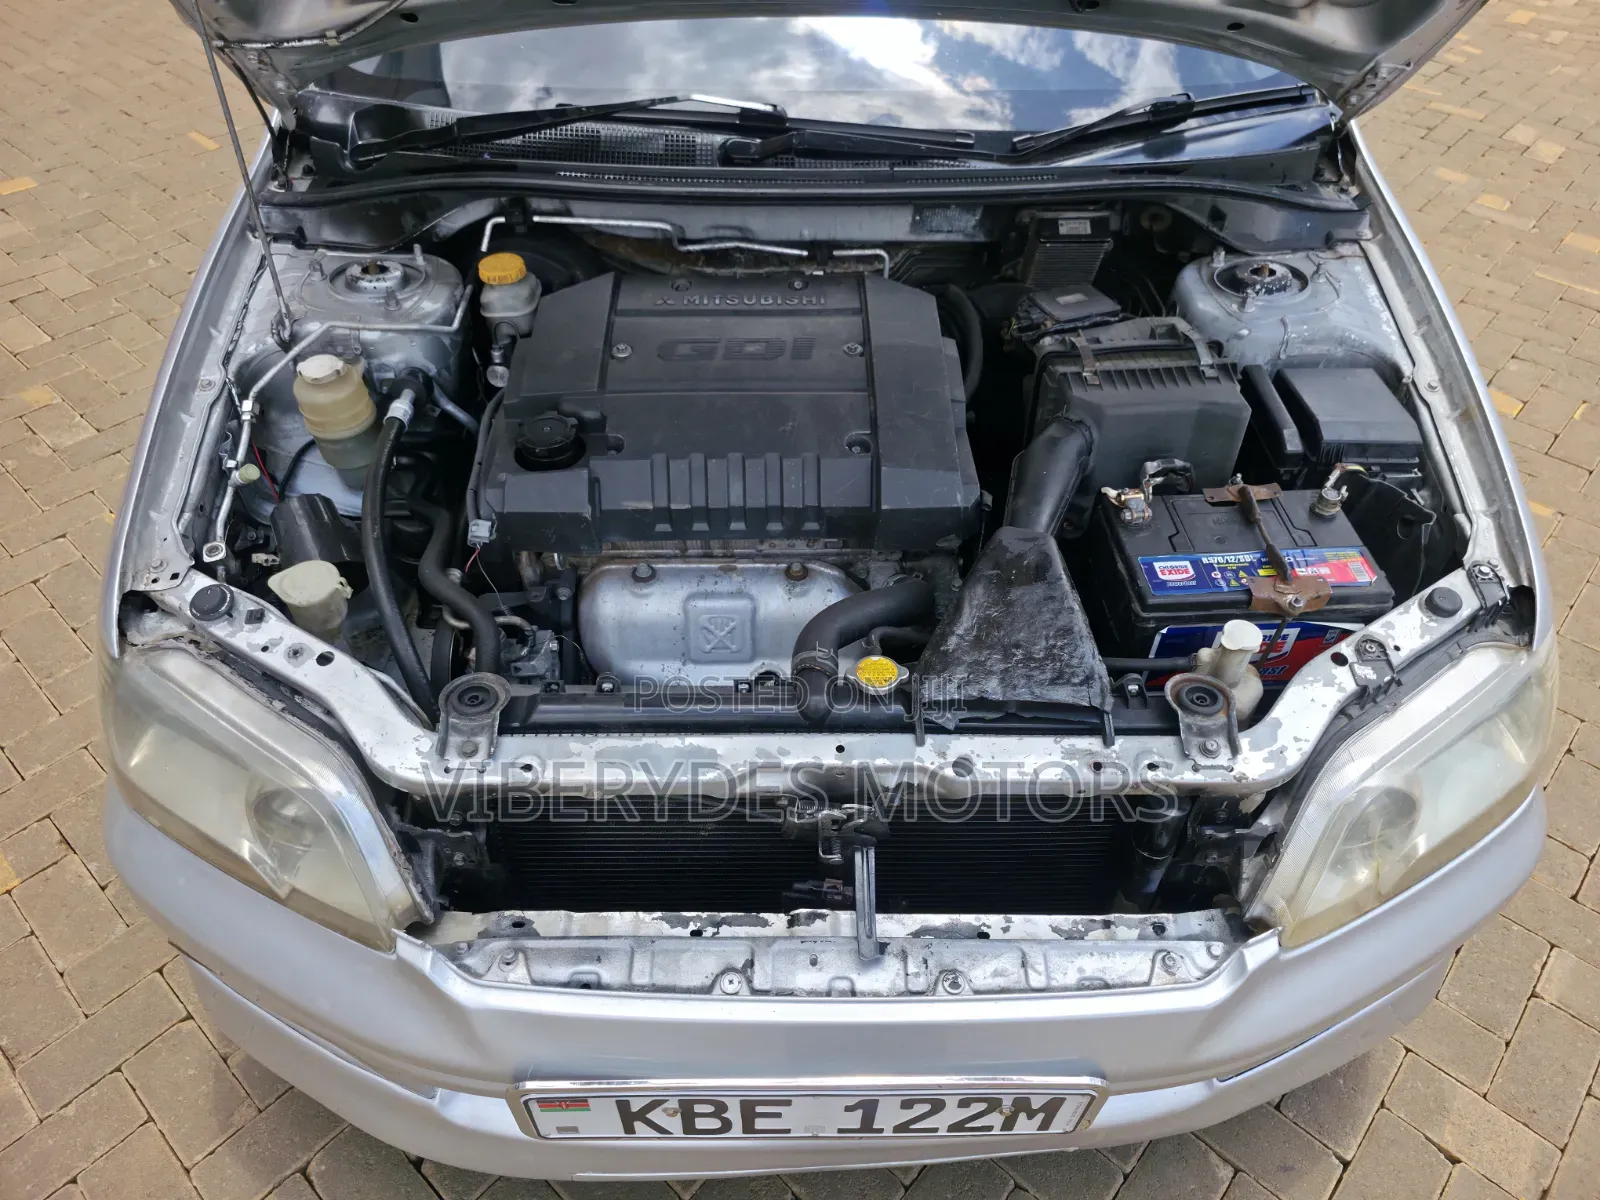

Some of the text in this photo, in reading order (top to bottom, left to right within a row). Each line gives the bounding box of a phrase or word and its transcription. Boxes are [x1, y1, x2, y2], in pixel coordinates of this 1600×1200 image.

[683, 294, 827, 306] MITSUBISHI
[657, 337, 816, 361] GDI
[615, 1098, 793, 1135] KBE
[836, 1096, 1067, 1134] 122M
